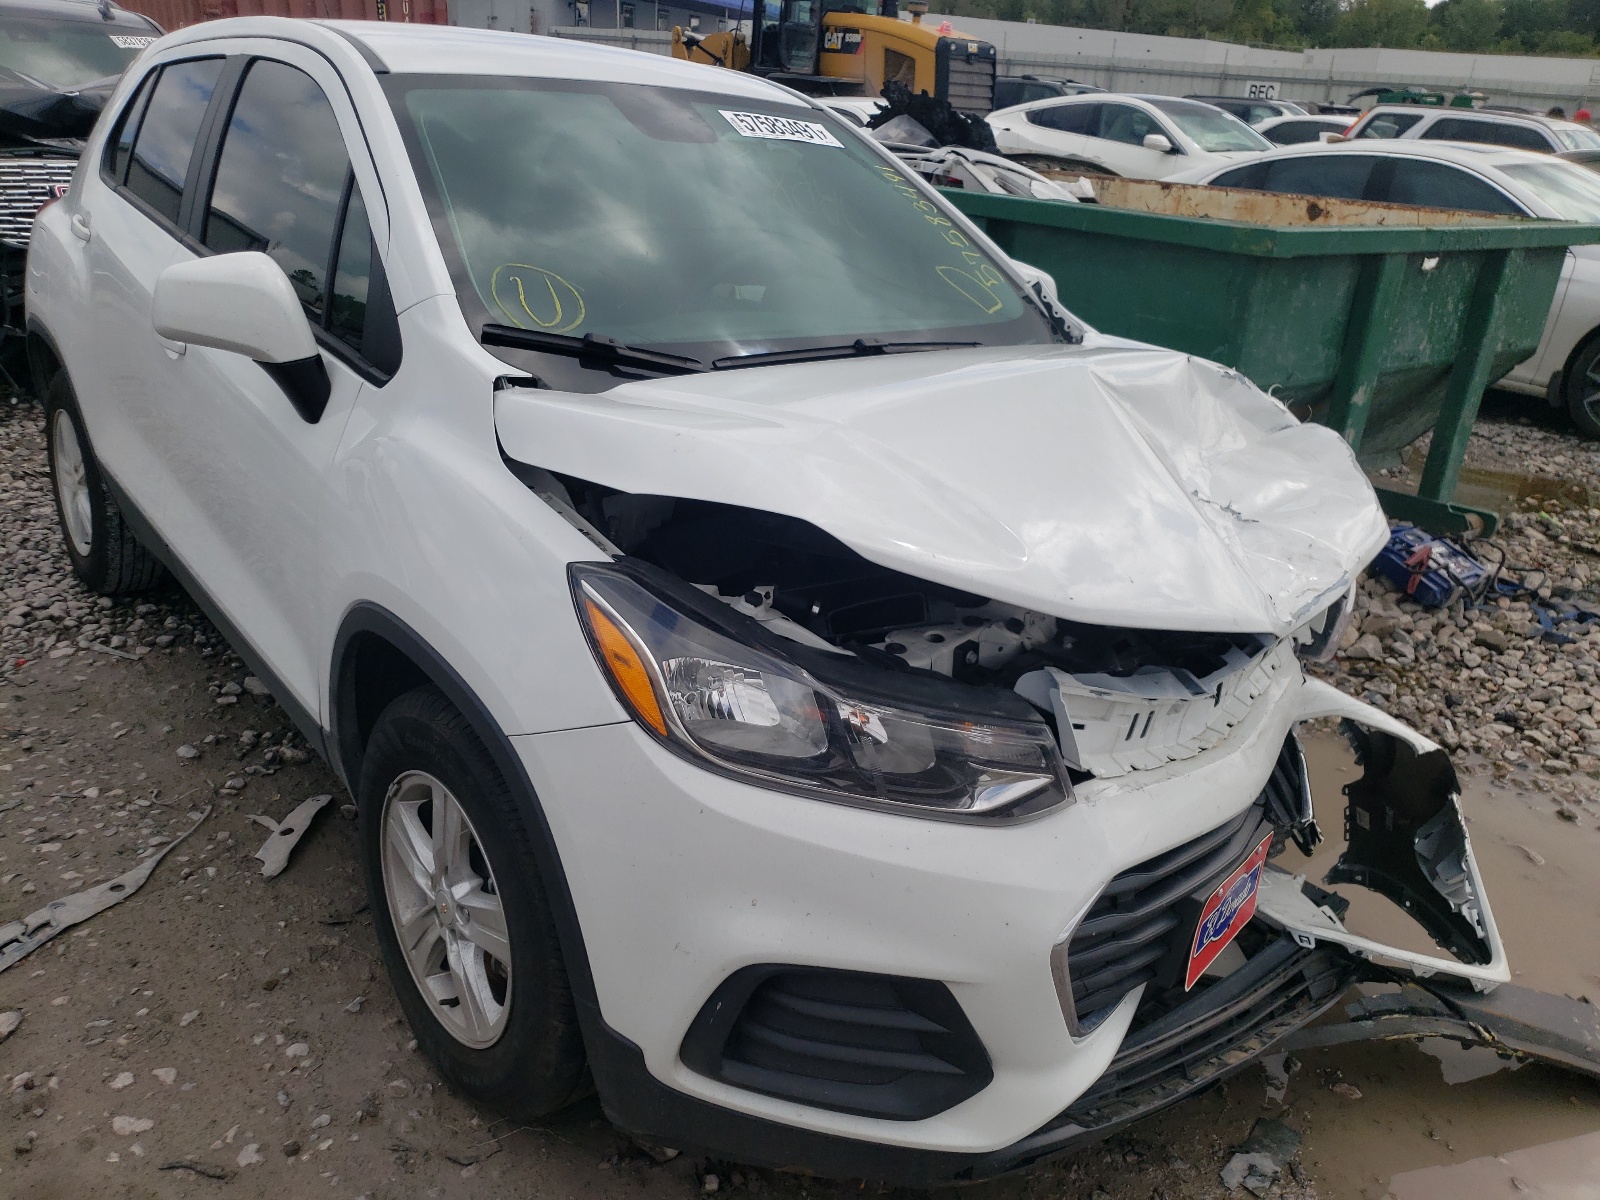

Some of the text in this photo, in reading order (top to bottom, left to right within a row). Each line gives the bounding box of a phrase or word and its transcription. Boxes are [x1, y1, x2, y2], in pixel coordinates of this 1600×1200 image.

[824, 31, 843, 49] CAT
[733, 113, 824, 140] 57583491
[874, 165, 1005, 287] 57583491
